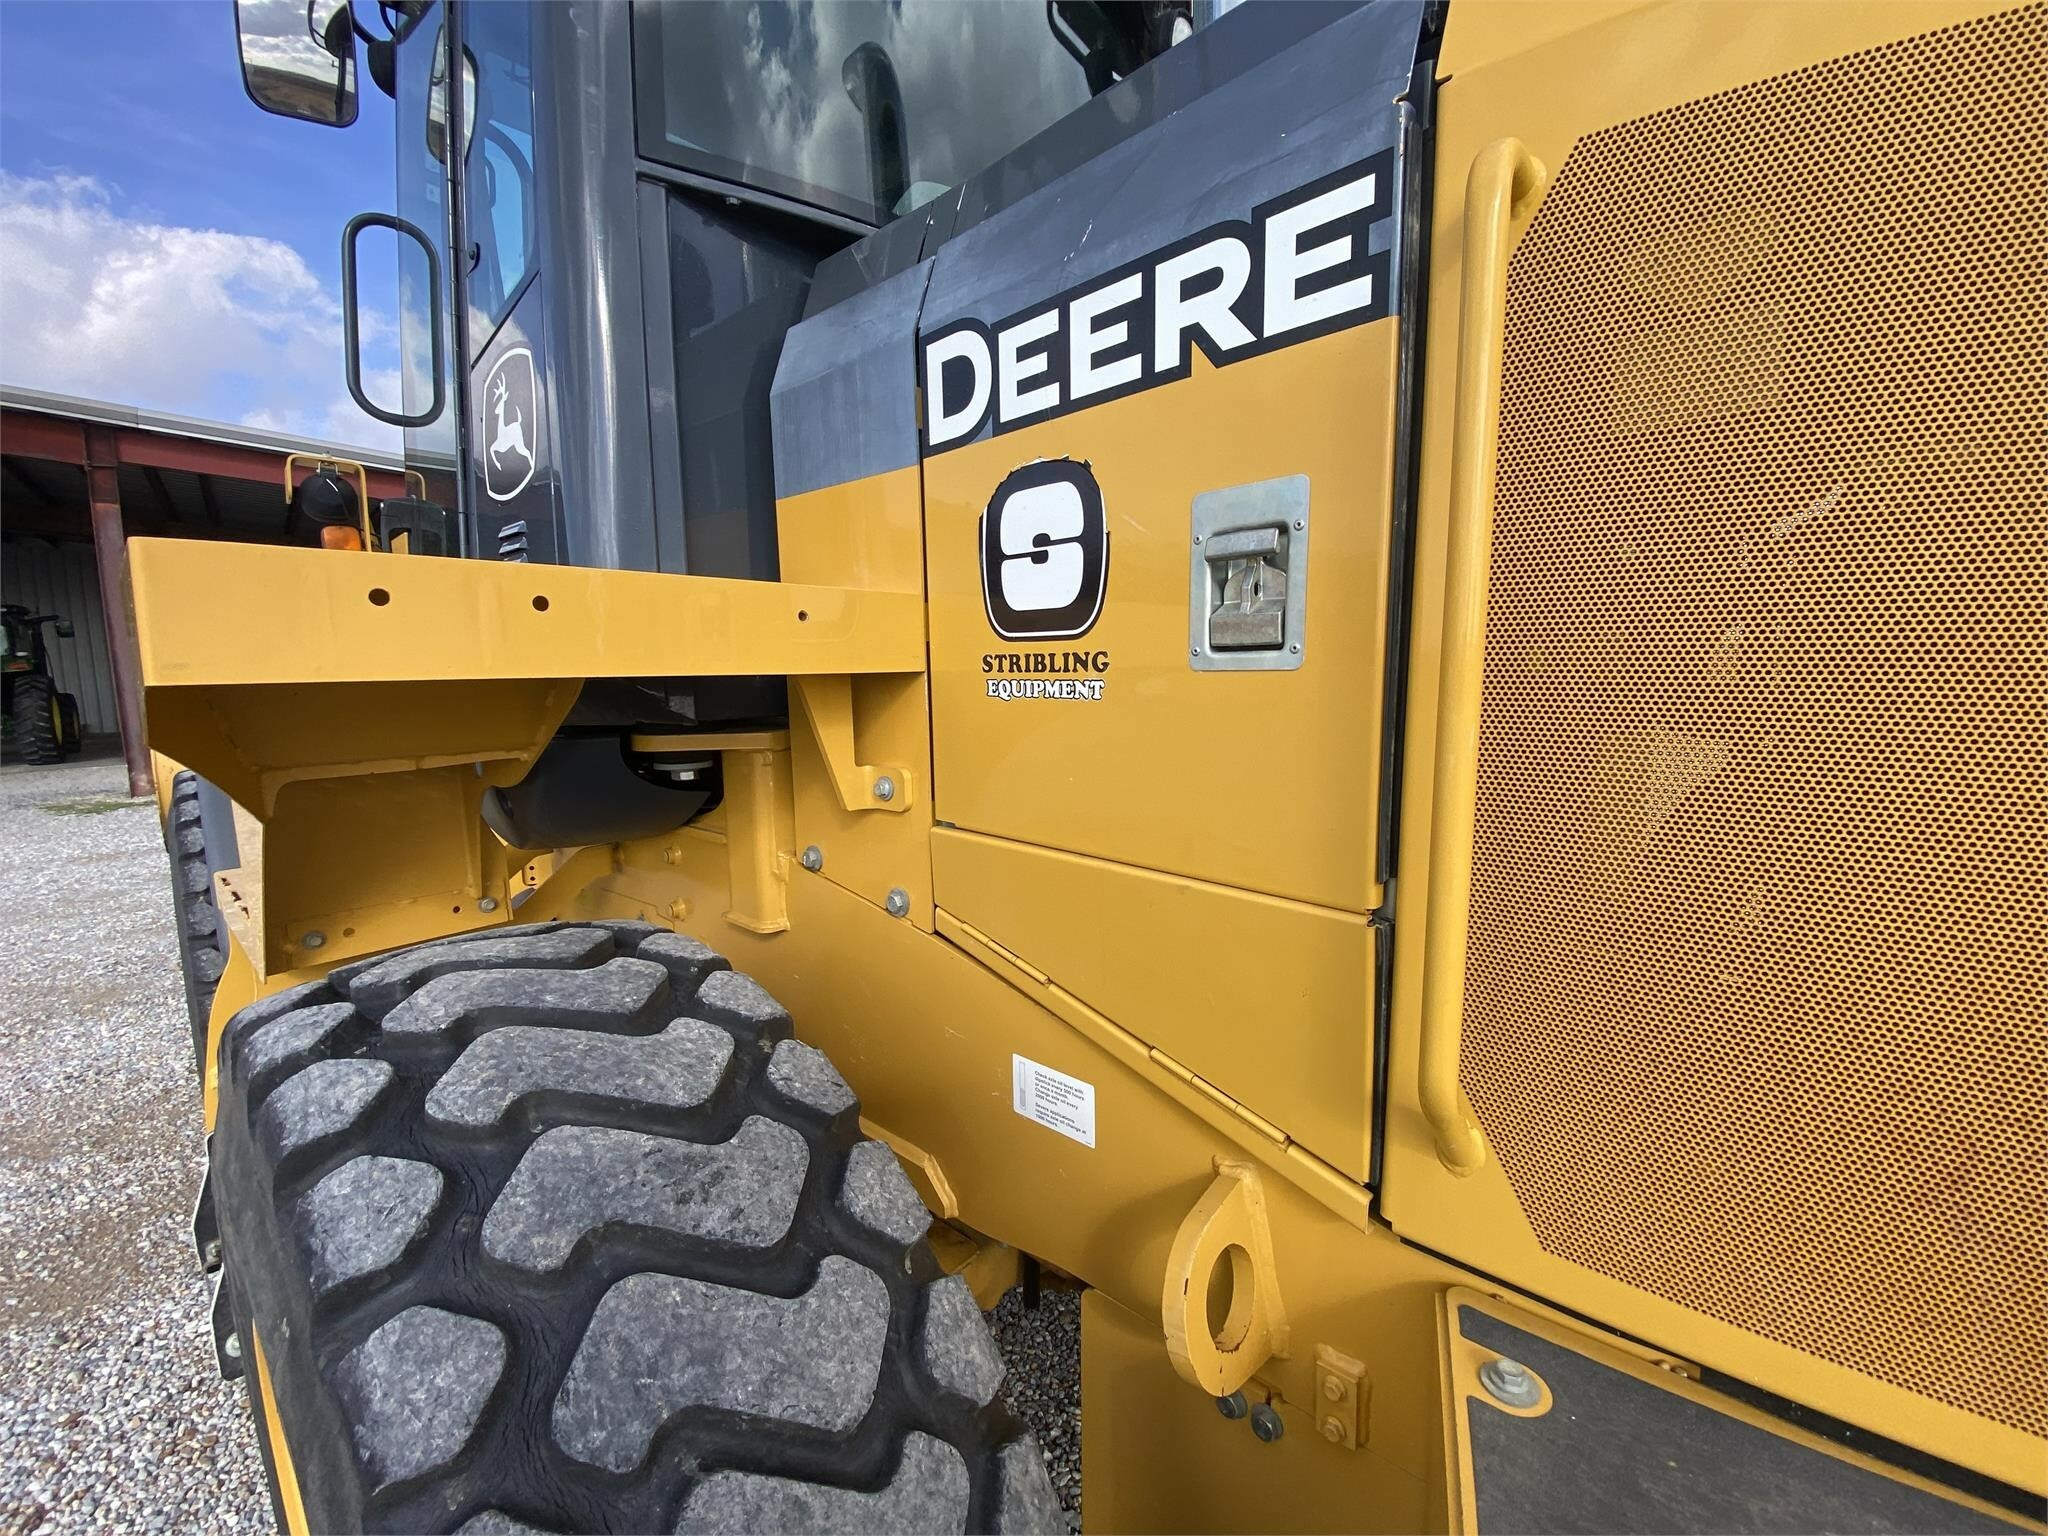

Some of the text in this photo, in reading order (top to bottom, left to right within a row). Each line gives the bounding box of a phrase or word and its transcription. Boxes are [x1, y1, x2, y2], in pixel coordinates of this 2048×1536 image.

[925, 172, 1376, 446] DEERE
[1000, 481, 1084, 611] S
[981, 650, 1110, 673] STRIBLING
[986, 678, 1105, 701] EQUIPMENT
